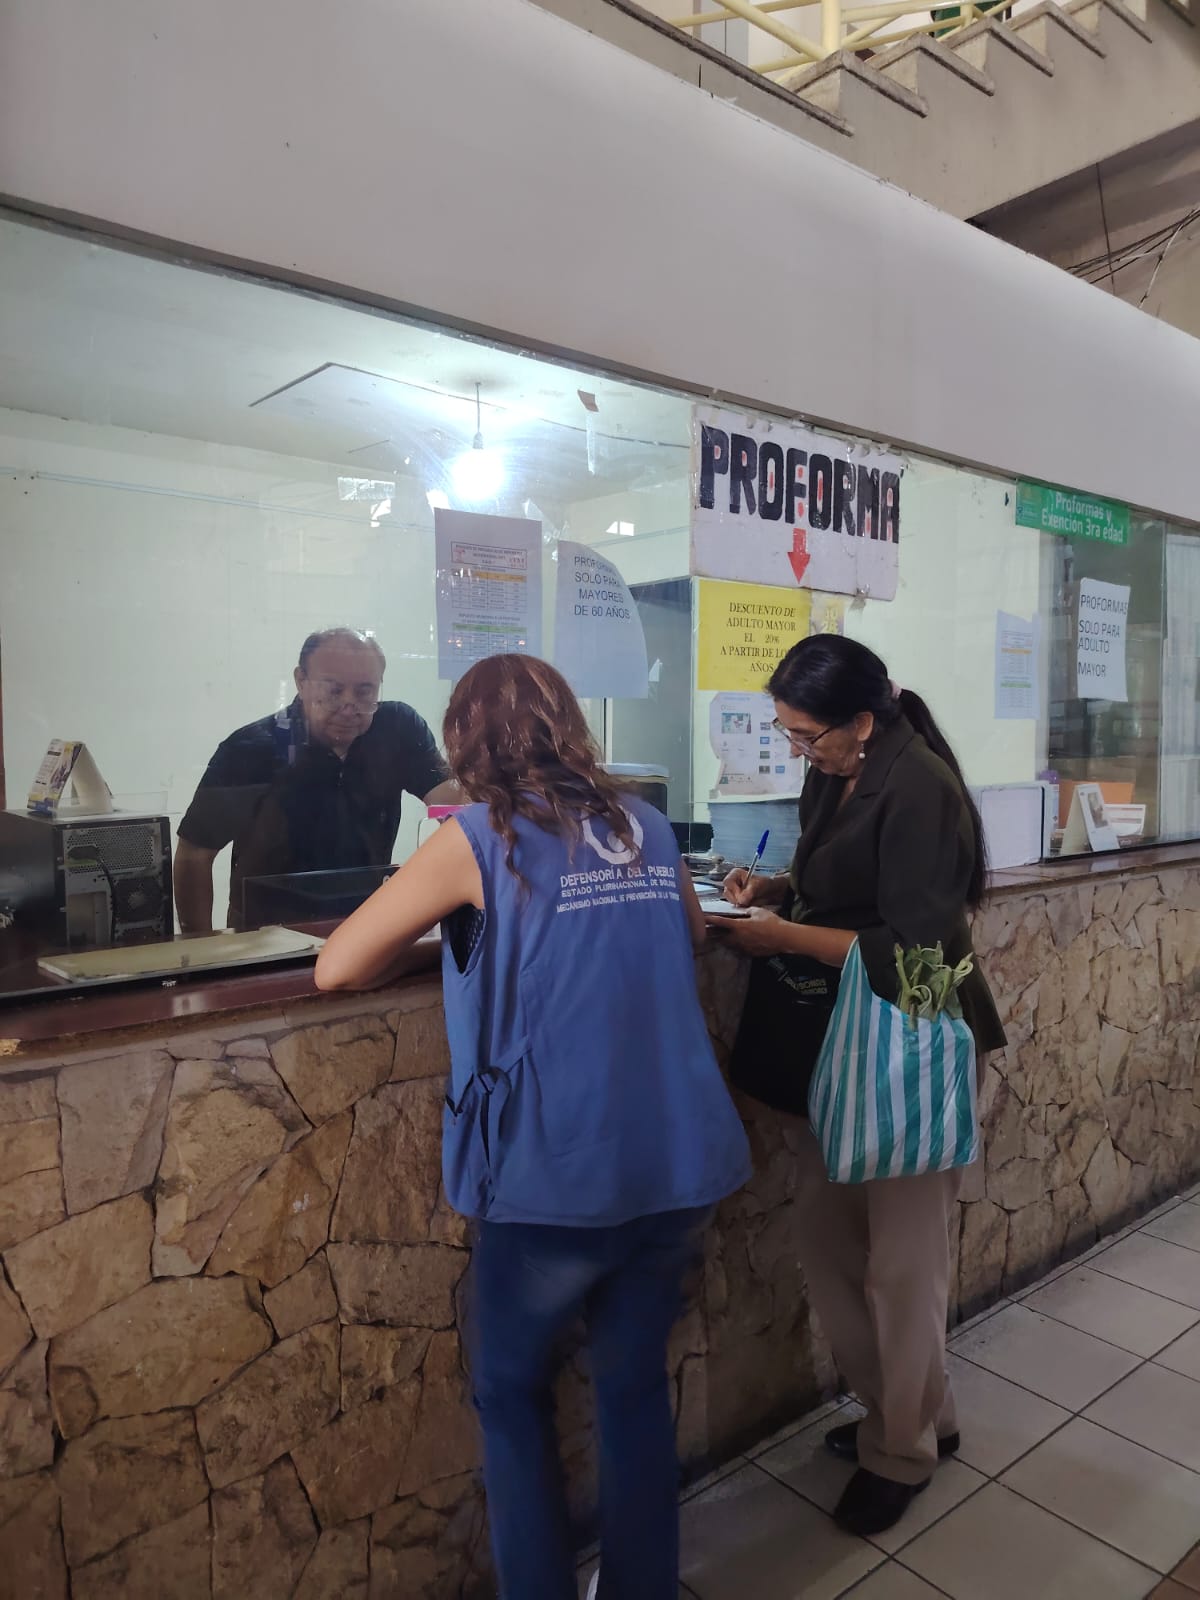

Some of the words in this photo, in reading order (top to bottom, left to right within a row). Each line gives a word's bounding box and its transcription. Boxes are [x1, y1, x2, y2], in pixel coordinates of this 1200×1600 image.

[700, 425, 899, 544] PROFORMA
[1055, 491, 1104, 519] Proformas
[1105, 509, 1112, 526] y
[1041, 508, 1083, 534] Exención
[1085, 518, 1101, 538] 3ra
[1103, 523, 1123, 542] edad
[574, 571, 602, 585] SOLO
[578, 588, 624, 604] MAYORES
[574, 604, 589, 616] DE
[591, 605, 603, 617] 60
[605, 605, 631, 620] AÑOS
[729, 602, 782, 617] DESCUENTO
[784, 607, 797, 618] DE
[1080, 594, 1128, 615] PROFORMAS
[726, 617, 764, 629] ADULTO
[765, 619, 796, 631] MAYOR
[1078, 619, 1100, 635] SOLO
[1102, 623, 1120, 638] PARA
[744, 632, 755, 643] EL
[1078, 637, 1110, 654] ADULTO
[720, 645, 727, 656] A
[729, 646, 760, 657] PARTIR
[762, 647, 774, 658] DE
[750, 660, 774, 673] AÑOS
[1078, 662, 1106, 677] MAYOR
[560, 865, 623, 888] DEFENSORÍA
[627, 866, 645, 878] DEL
[647, 865, 675, 878] PUEBLO
[561, 886, 593, 898] ESTADO
[595, 879, 649, 893] PLURINACIONAL
